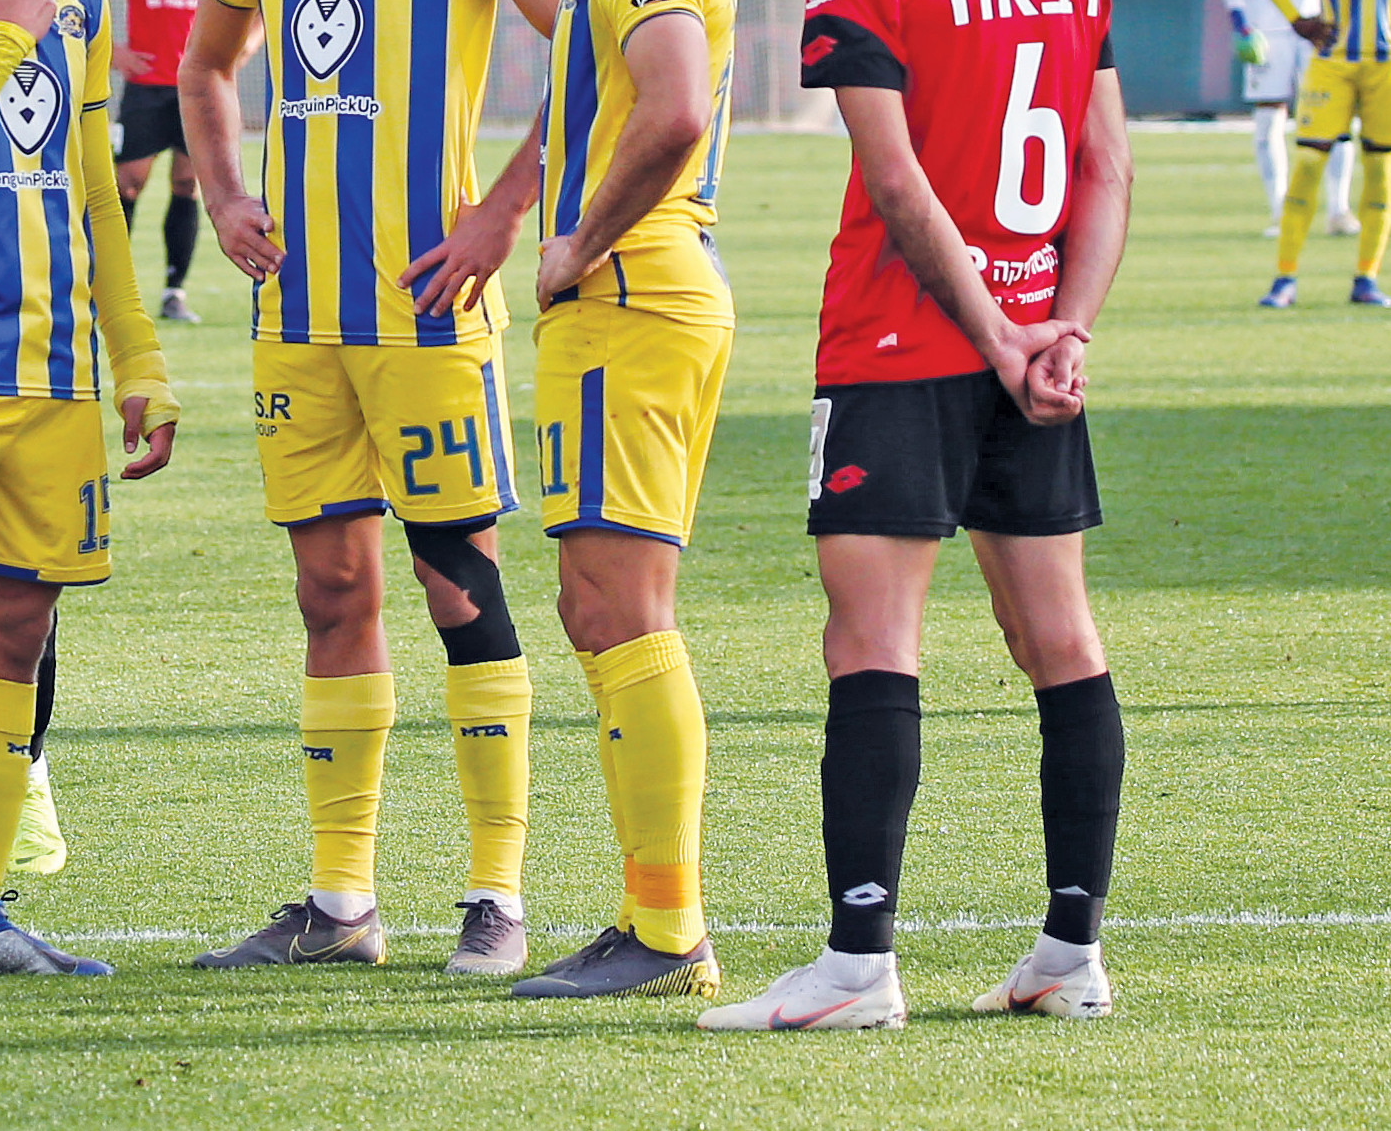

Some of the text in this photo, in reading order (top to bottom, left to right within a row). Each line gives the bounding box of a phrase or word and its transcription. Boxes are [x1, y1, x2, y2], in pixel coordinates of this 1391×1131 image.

[281, 96, 380, 118] PenguinPickUp
[994, 41, 1067, 236] 6
[399, 415, 484, 497] 24
